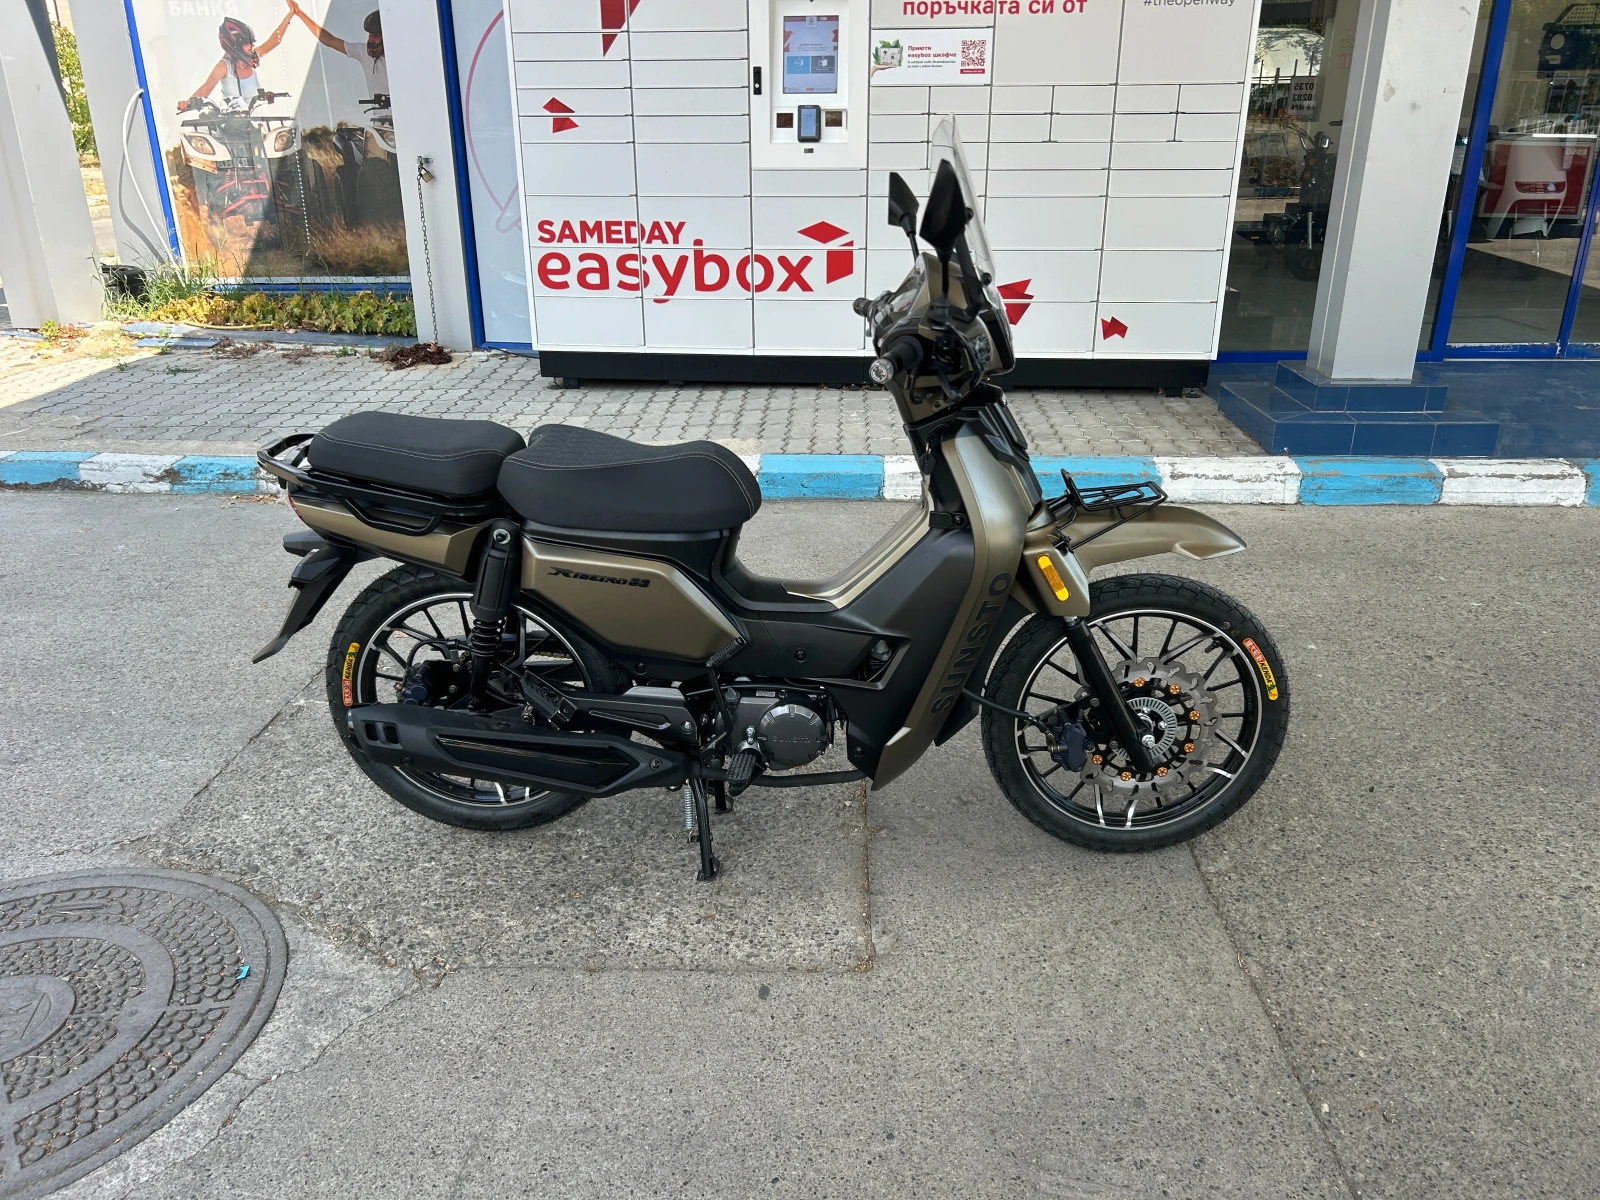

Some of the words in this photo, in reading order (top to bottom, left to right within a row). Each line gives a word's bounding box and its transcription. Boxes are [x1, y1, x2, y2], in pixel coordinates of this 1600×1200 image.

[168, 0, 239, 16] БАНКЯ
[903, 0, 1020, 18] поръчката
[1028, 0, 1054, 14] си
[1062, 0, 1088, 13] от
[537, 219, 687, 245] SAMEDAY
[537, 239, 814, 304] easybox
[931, 572, 1011, 714] SUNSTO
[345, 659, 354, 679] KENDA
[1260, 662, 1272, 684] KENDA
